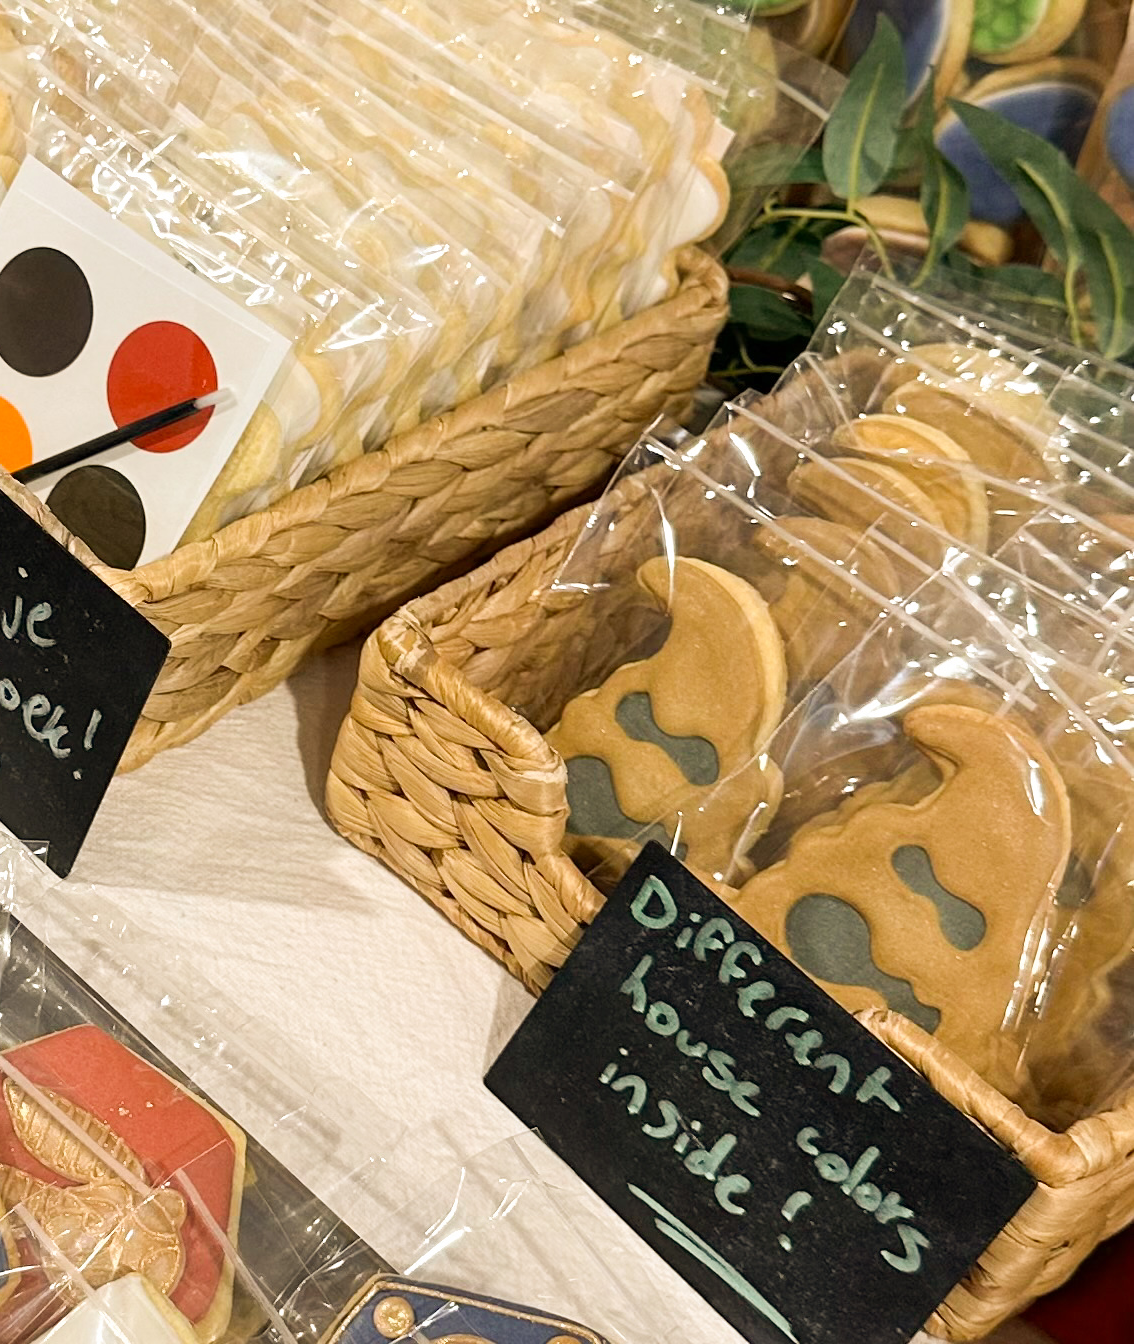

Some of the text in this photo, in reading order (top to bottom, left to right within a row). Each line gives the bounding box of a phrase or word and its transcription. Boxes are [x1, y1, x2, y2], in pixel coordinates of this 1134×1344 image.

[1, 566, 57, 647] je
[630, 875, 901, 1112] Different
[598, 1047, 751, 1216] inside
[621, 955, 930, 1272] house colors
